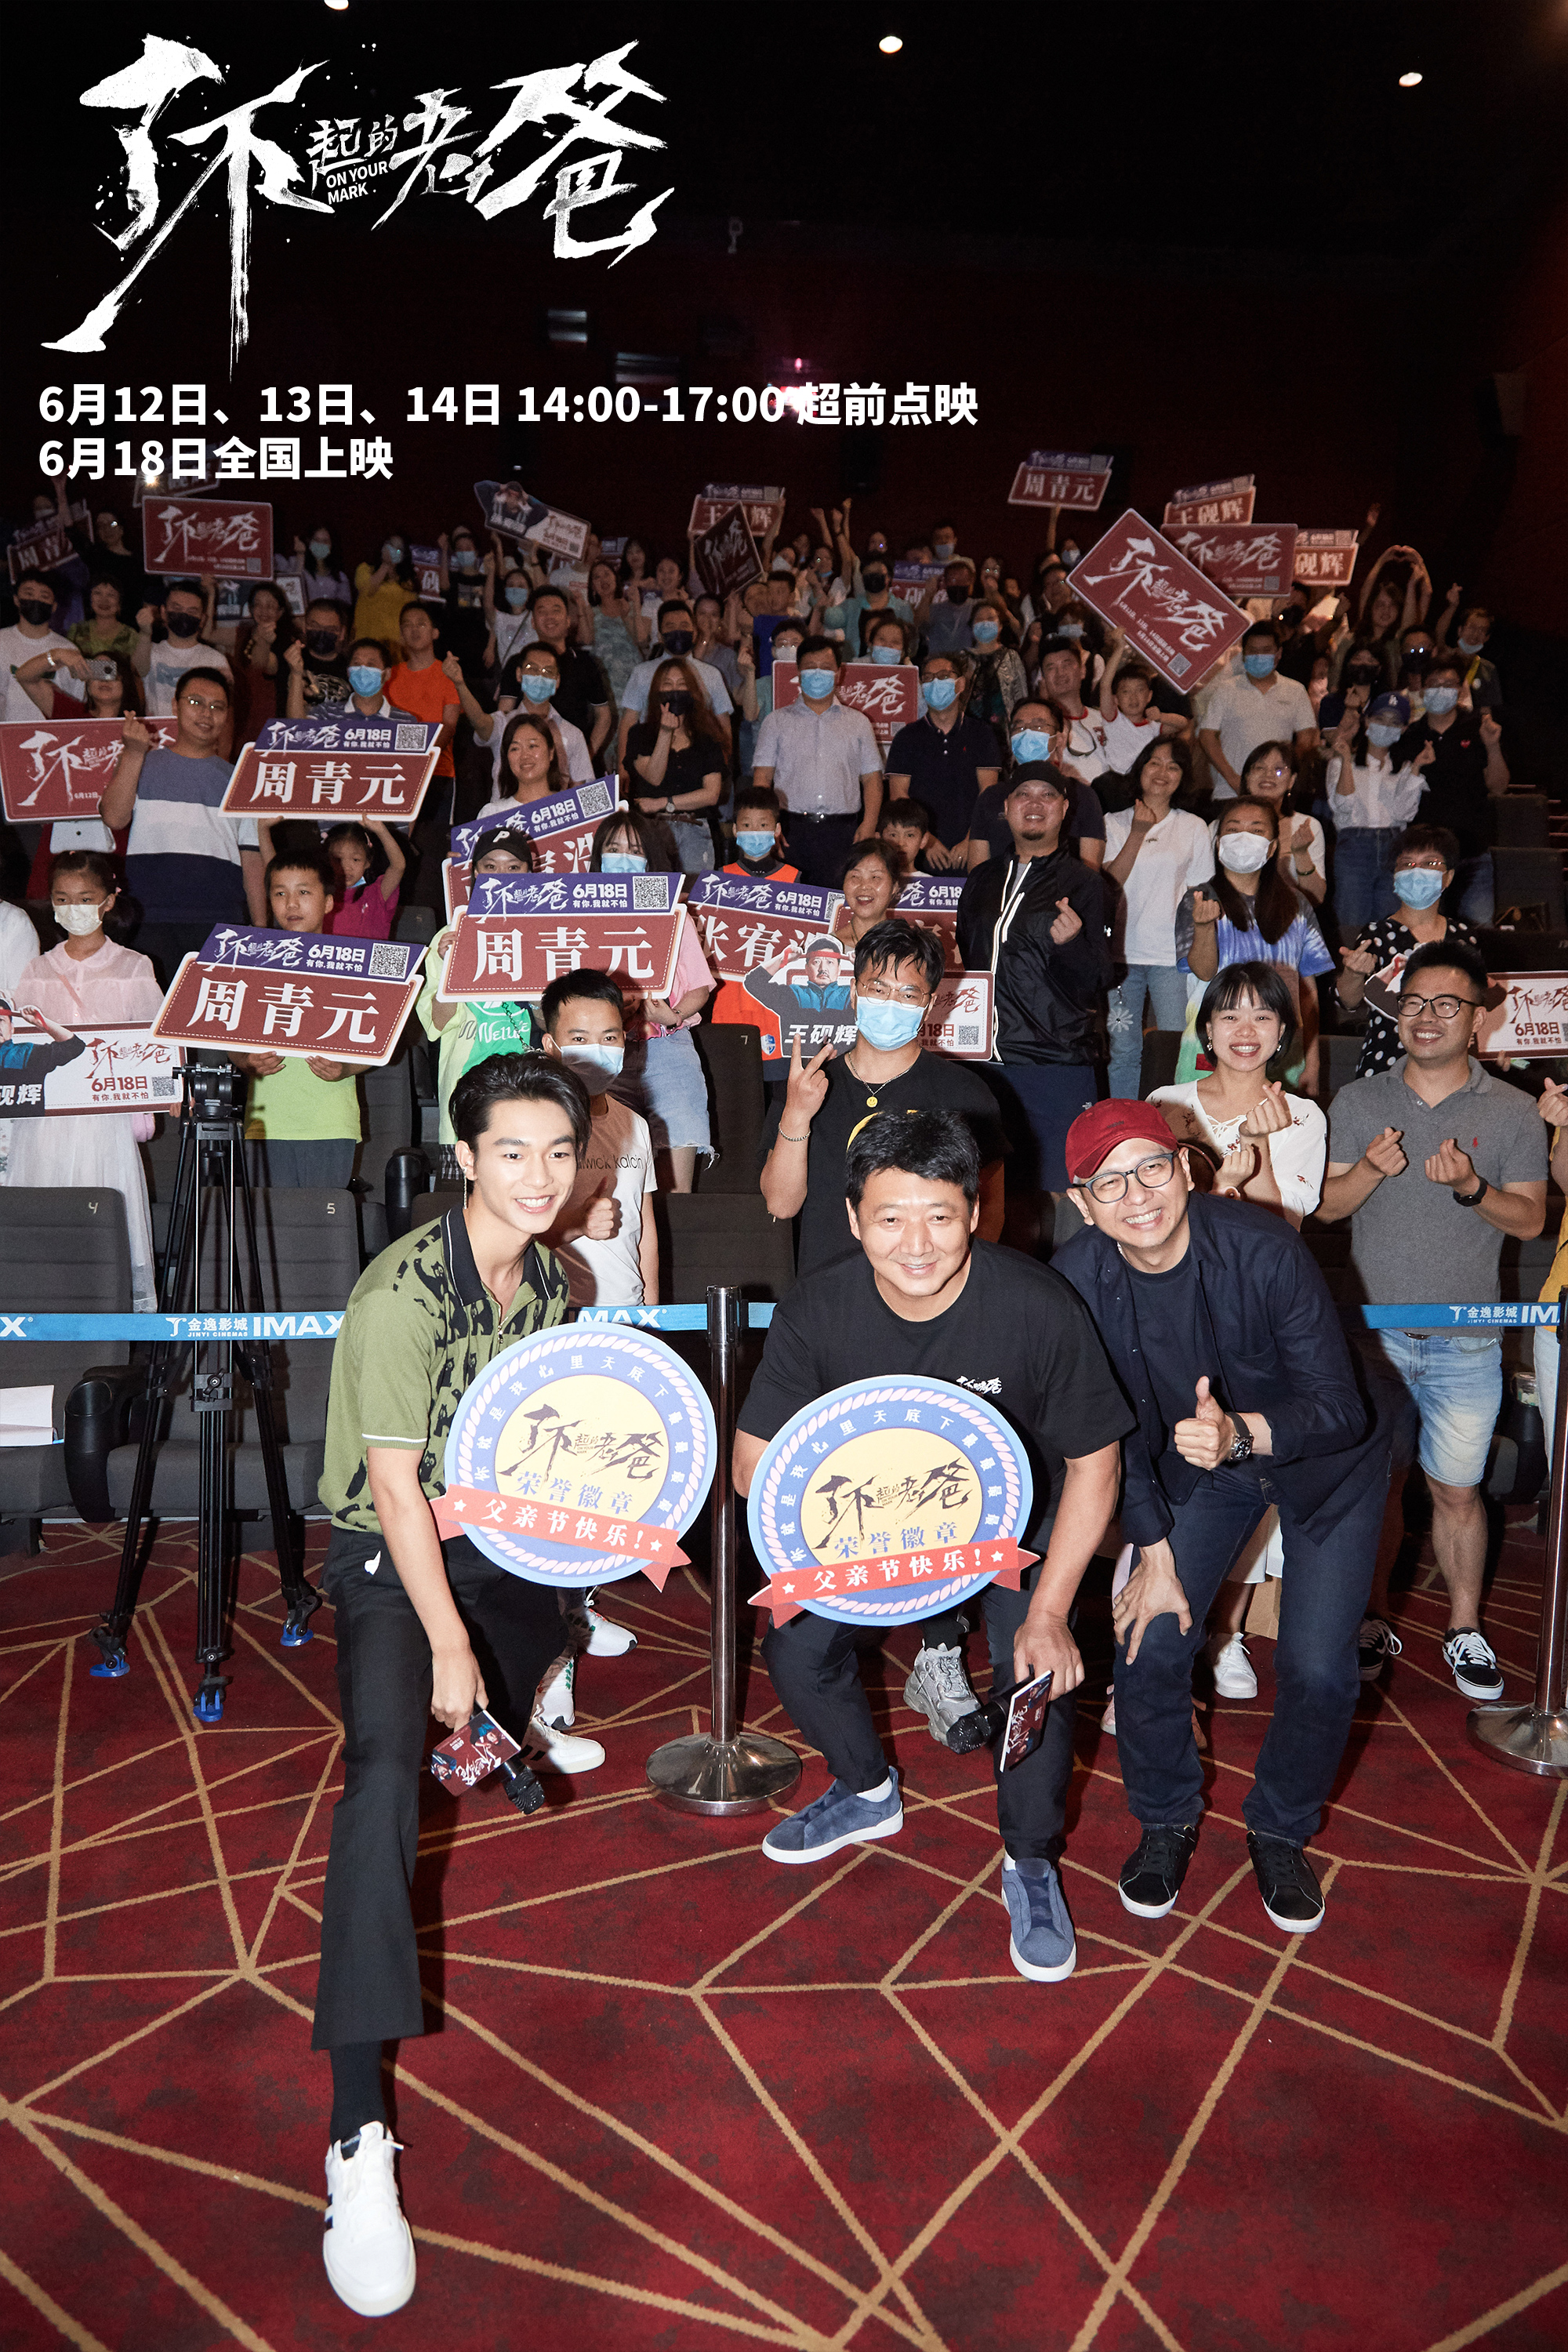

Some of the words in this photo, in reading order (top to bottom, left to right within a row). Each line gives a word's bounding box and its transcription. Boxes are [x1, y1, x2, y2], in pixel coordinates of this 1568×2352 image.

[344, 728, 391, 742] 6月18日
[249, 760, 406, 805] 周青元
[531, 798, 576, 824] 6月18日
[492, 830, 510, 843] P
[572, 883, 627, 898] 6月18日
[475, 877, 570, 924] 了不起的老爸
[776, 891, 822, 909] 6月18日
[202, 928, 306, 975] 了不起的老爸
[307, 946, 366, 964] 6月18日
[473, 926, 655, 982] 周青元
[186, 977, 380, 1044] 周青元
[784, 1024, 858, 1045] 王砚辉
[1515, 1022, 1560, 1036] 6月18日
[91, 1076, 147, 1092] 6月18日
[89, 1202, 98, 1214] 4
[327, 1203, 336, 1214] 5
[1467, 1305, 1518, 1319] 金逸影城
[1521, 1305, 1559, 1323] IM
[187, 1317, 249, 1331] 金逸影城
[496, 1403, 665, 1486] 了不起的老爸
[516, 1470, 633, 1515] 荣誉徽章
[811, 1457, 973, 1550] 了不起的老爸
[834, 1522, 958, 1559] 荣誉徽章
